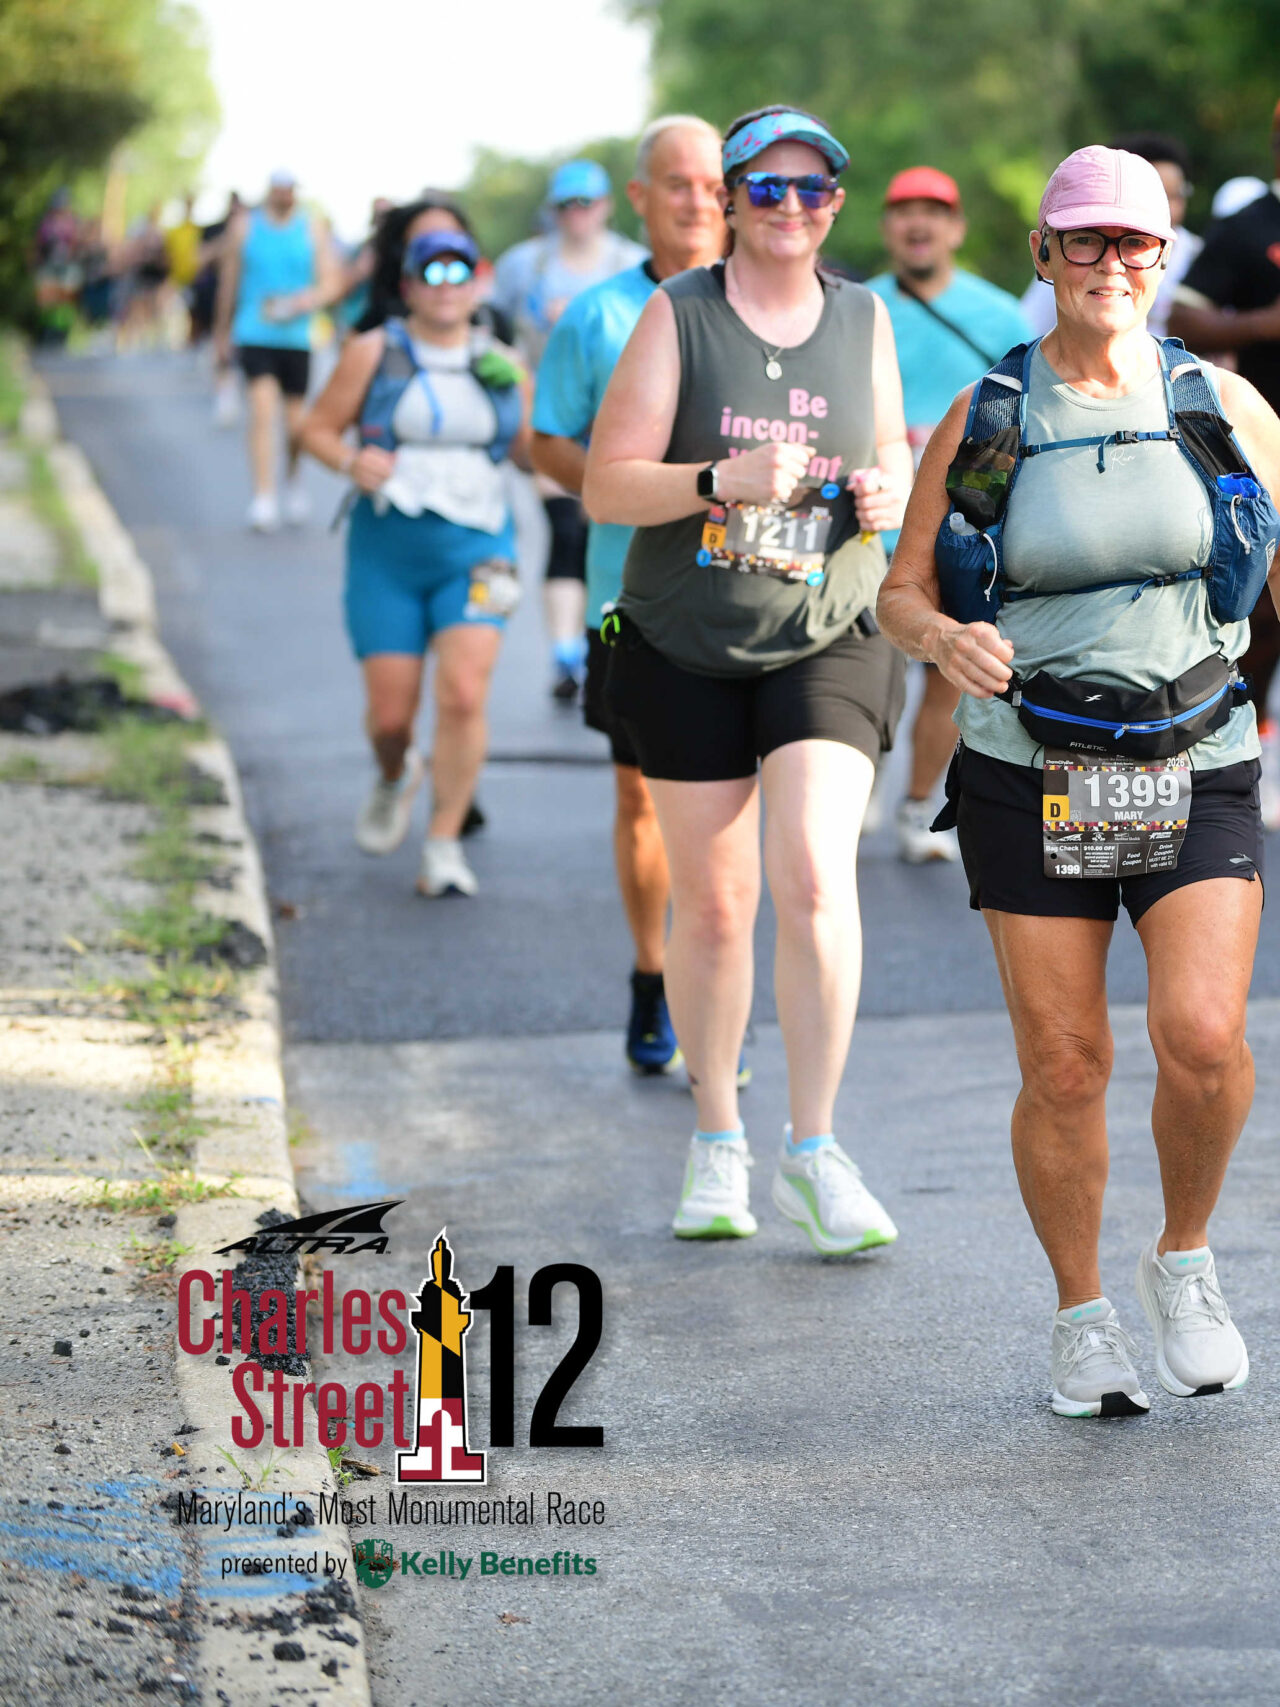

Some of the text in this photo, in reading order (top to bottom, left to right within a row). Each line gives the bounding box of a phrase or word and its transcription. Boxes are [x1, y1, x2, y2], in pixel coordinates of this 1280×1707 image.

[789, 388, 828, 418] Be
[720, 406, 819, 444] incon-
[709, 533, 717, 543] D
[743, 512, 818, 551] 1211
[1084, 774, 1179, 808] 1399
[1050, 803, 1060, 817] D
[1114, 811, 1144, 820] MARY
[1055, 864, 1080, 874] 1399
